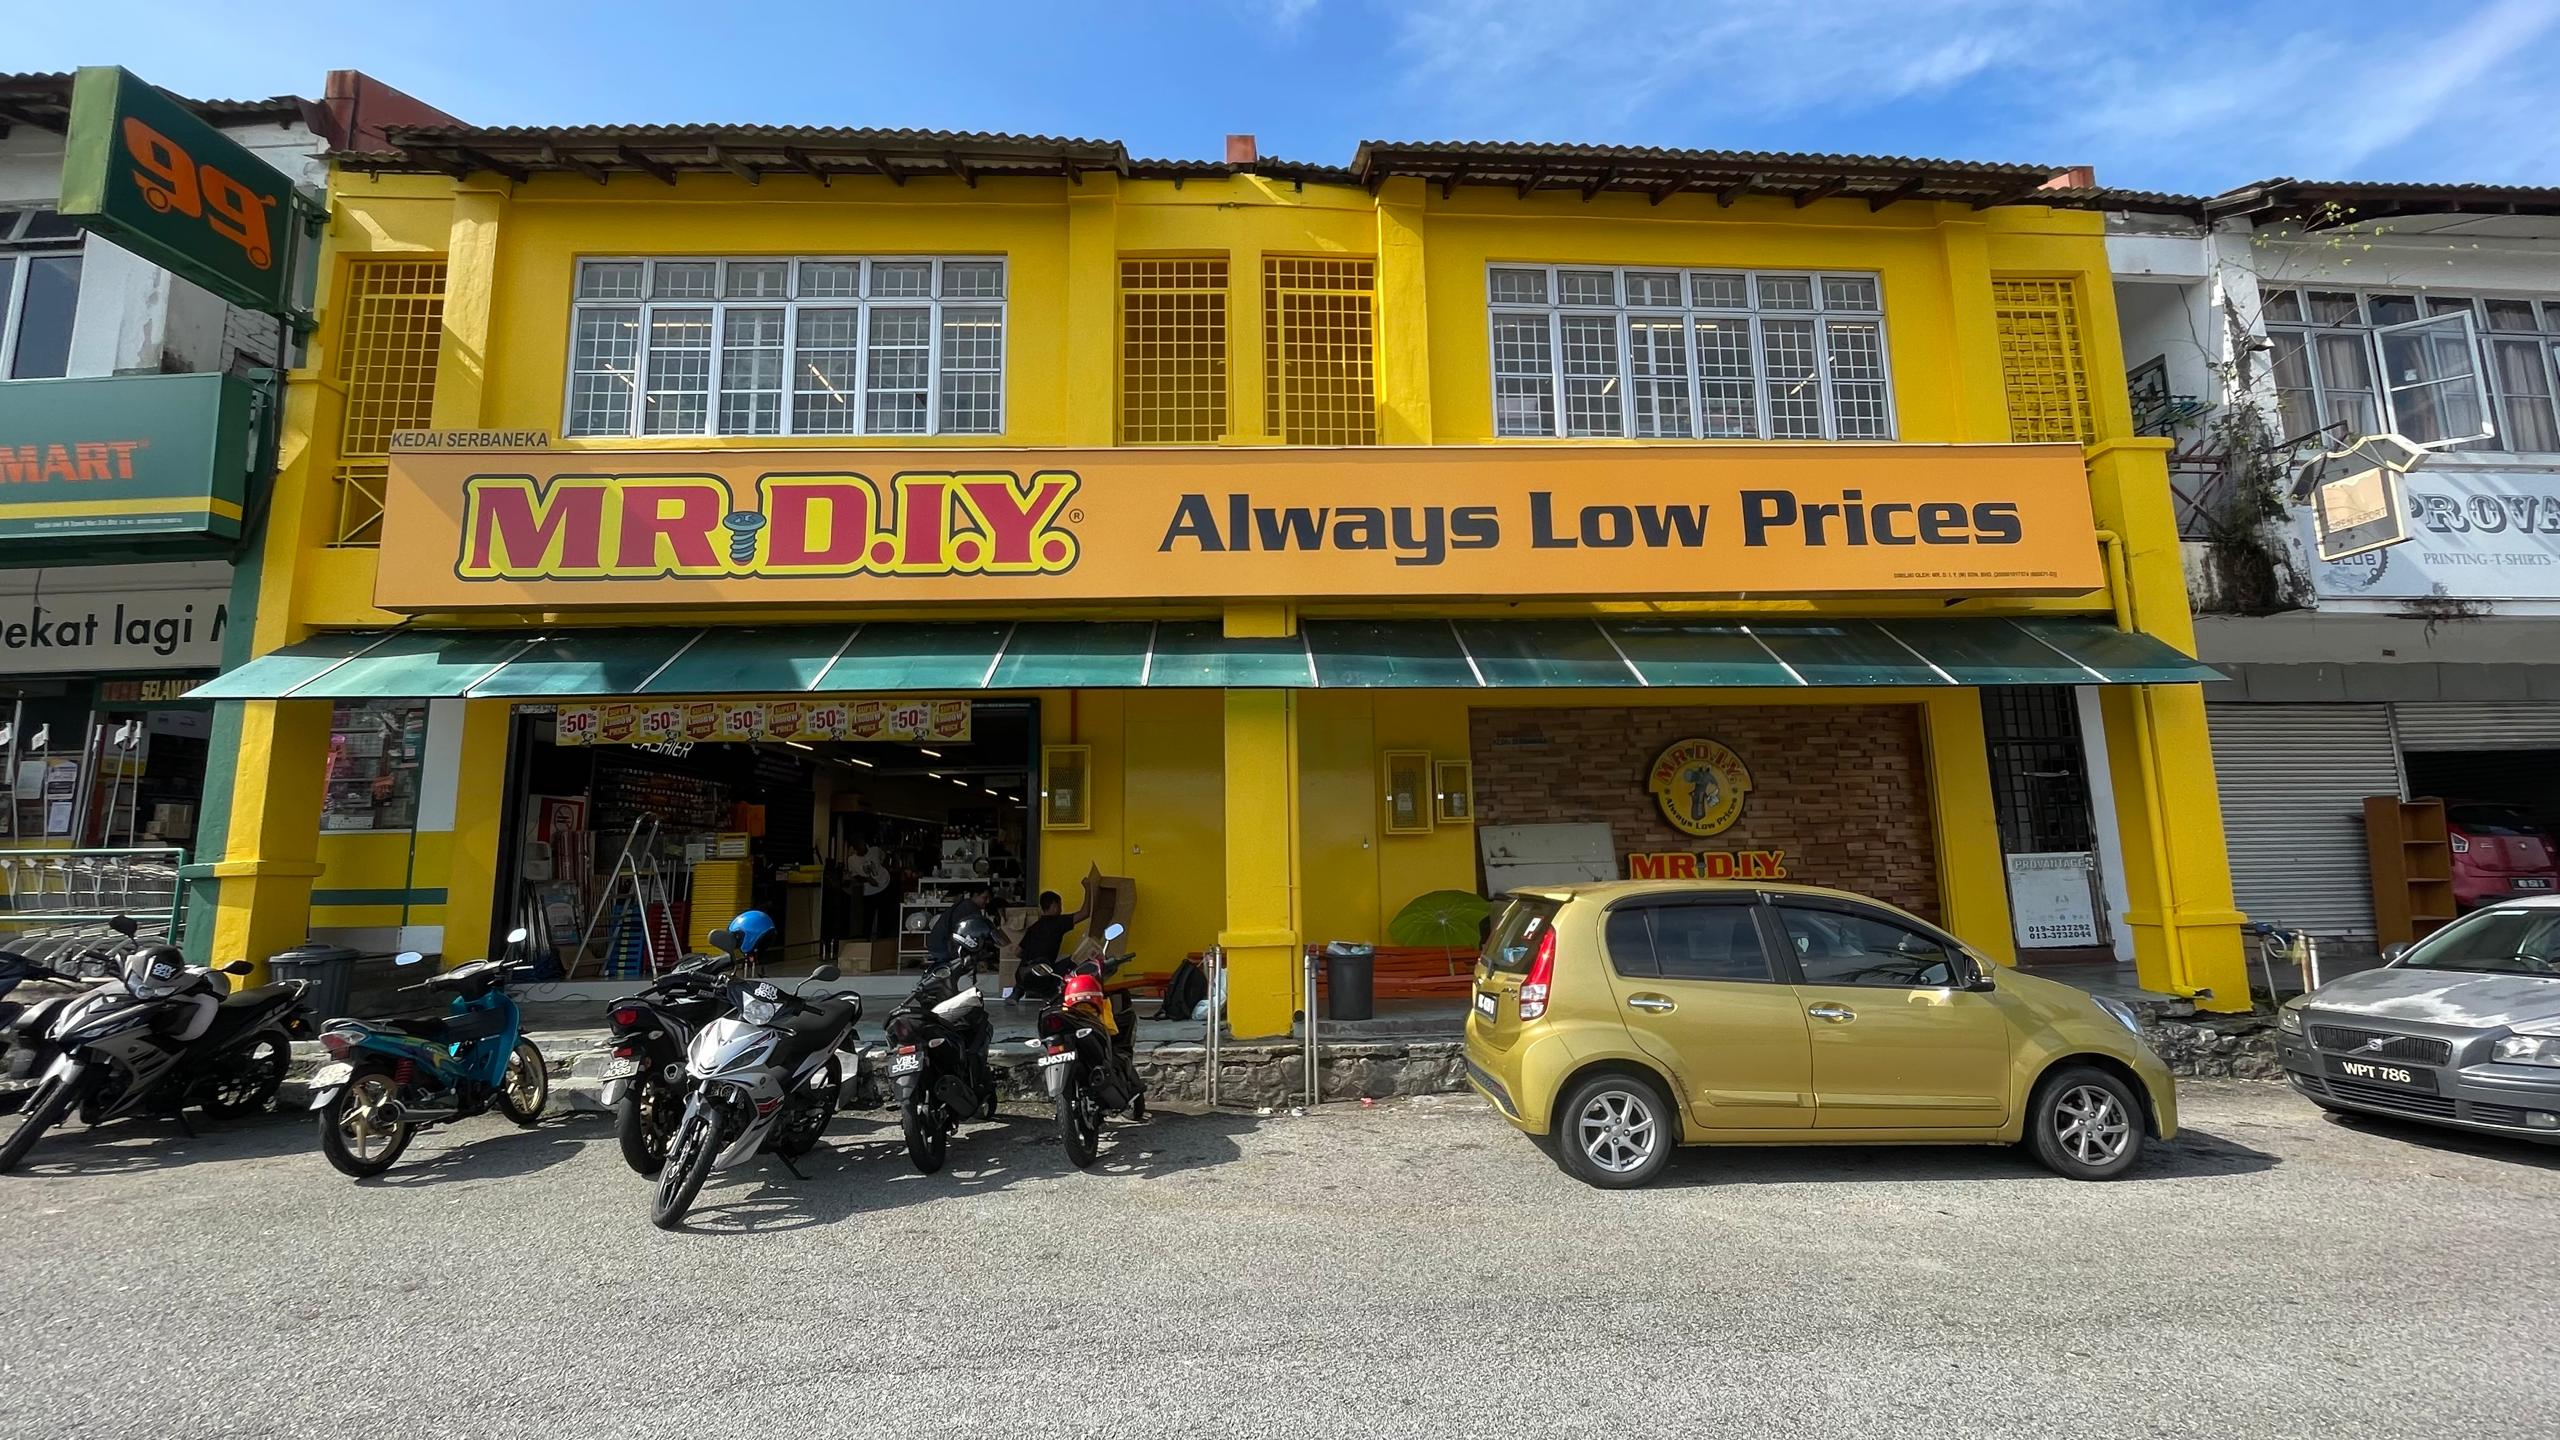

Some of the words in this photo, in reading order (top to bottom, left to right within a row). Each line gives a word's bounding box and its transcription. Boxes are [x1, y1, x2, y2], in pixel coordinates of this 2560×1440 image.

[123, 116, 278, 271] 99
[391, 433, 443, 447] KEDAI
[446, 433, 548, 447] SERBANEKA
[1157, 493, 1500, 566] Always
[1528, 491, 1709, 549] Low
[1739, 489, 2023, 546] Prices
[2331, 554, 2377, 566] LUB
[0, 606, 98, 648] ekat
[114, 603, 193, 655] lagi
[631, 742, 695, 759] SHIER
[1666, 798, 1693, 828] Always
[1695, 822, 1716, 830] Low
[1716, 798, 1738, 825] Prices
[2342, 1061, 2376, 1078] WPT
[2378, 1066, 2412, 1083] 786
